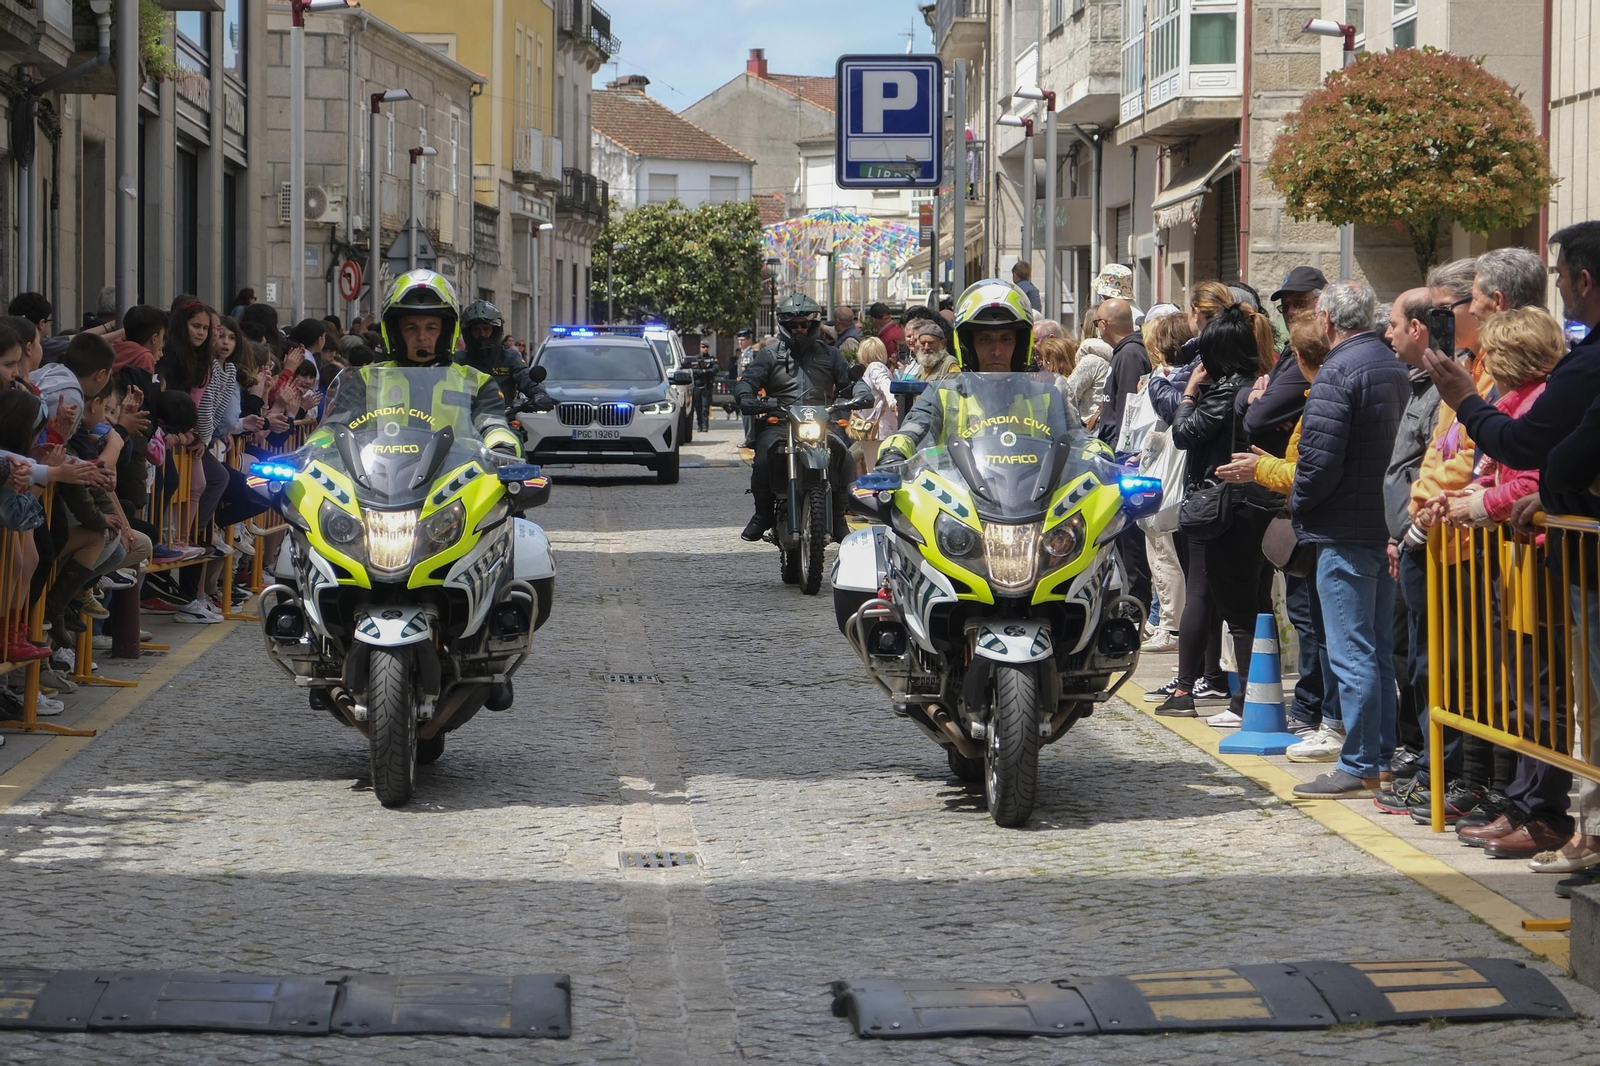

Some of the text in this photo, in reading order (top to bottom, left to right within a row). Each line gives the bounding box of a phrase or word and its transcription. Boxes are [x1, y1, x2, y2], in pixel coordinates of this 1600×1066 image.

[862, 70, 918, 133] P
[348, 407, 436, 430] GUARDIA CIVIL
[577, 430, 592, 438] PGC
[962, 415, 1052, 439] GUARDIA CIVIL
[372, 444, 420, 454] RAFICO
[985, 454, 1039, 464] TRAFICO
